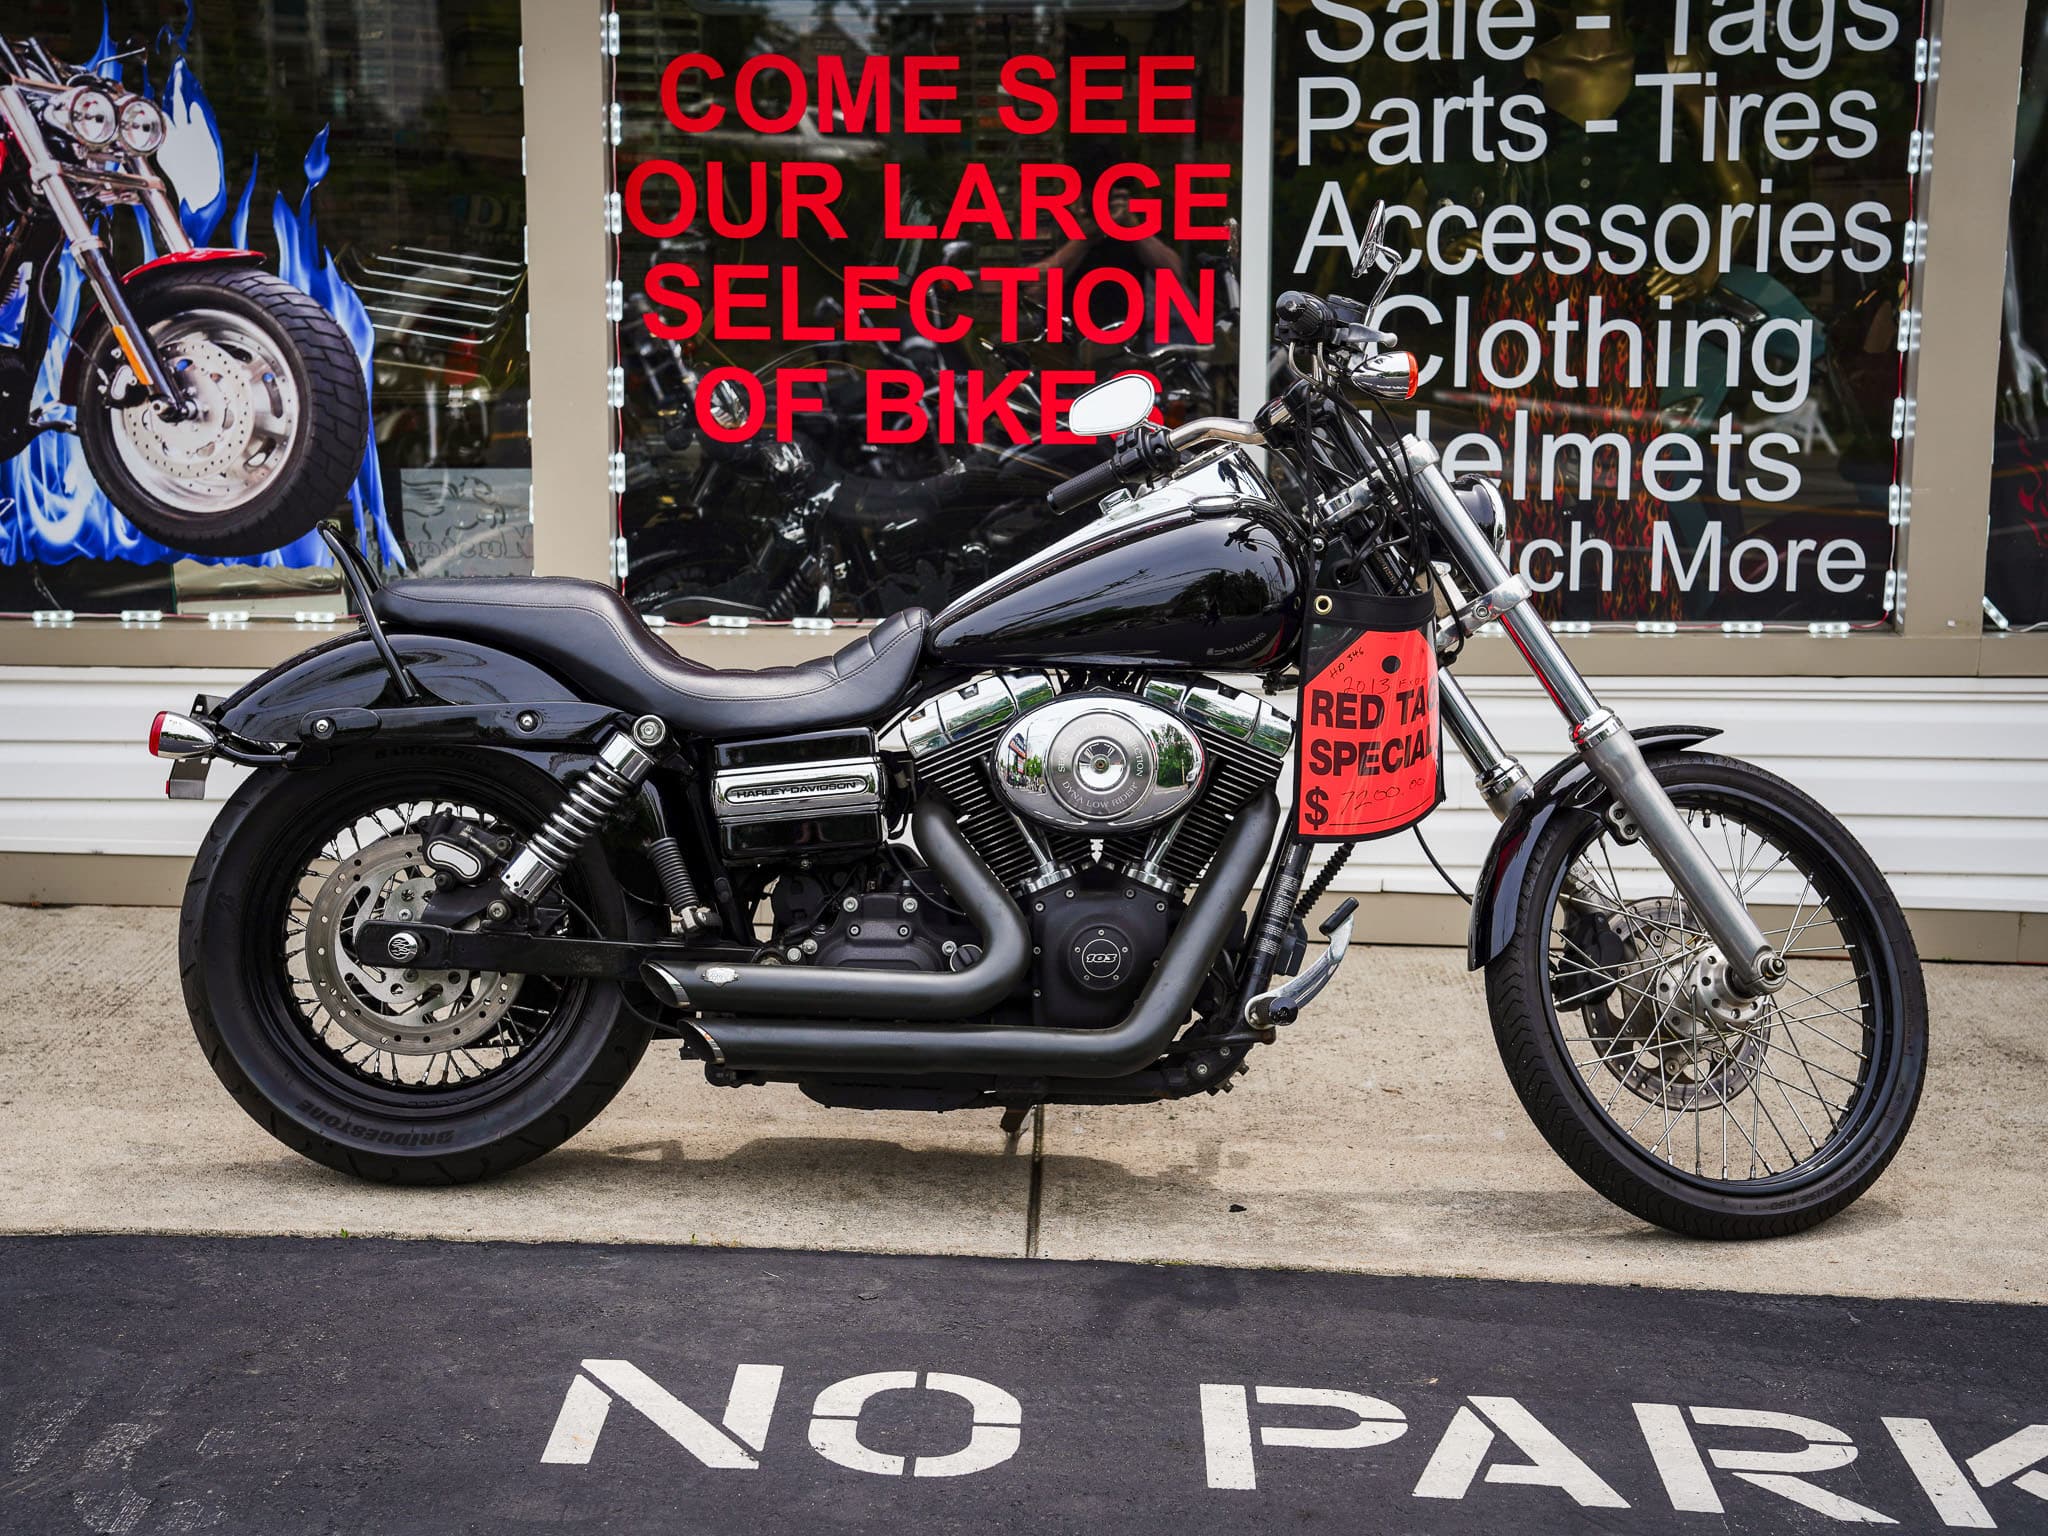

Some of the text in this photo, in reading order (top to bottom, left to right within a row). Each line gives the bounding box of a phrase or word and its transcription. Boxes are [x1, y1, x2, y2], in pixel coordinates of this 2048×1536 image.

[1305, 0, 1535, 63] Sale
[660, 53, 1196, 135] COME SEE
[1298, 75, 1547, 166] Parts
[1635, 72, 1878, 163] Tires
[625, 160, 1231, 241] OUR LARGE
[1293, 179, 1892, 275] Accessories
[642, 263, 1215, 345] SELECTION
[1364, 294, 1813, 413] Clothing
[693, 366, 828, 443] OF
[1502, 520, 1866, 593] ch More
[1310, 688, 1385, 730] RED
[1343, 676, 1391, 695] 2013
[1309, 725, 1432, 776] SPECIAL
[736, 781, 857, 799] HARLEY-DAVIDSON
[1062, 780, 1139, 809] DYNA LOW RIDER
[1303, 785, 1330, 831] $
[1086, 953, 1118, 963] 103
[295, 1100, 457, 1147] BRIDGESTONE
[539, 1358, 1022, 1478] NO
